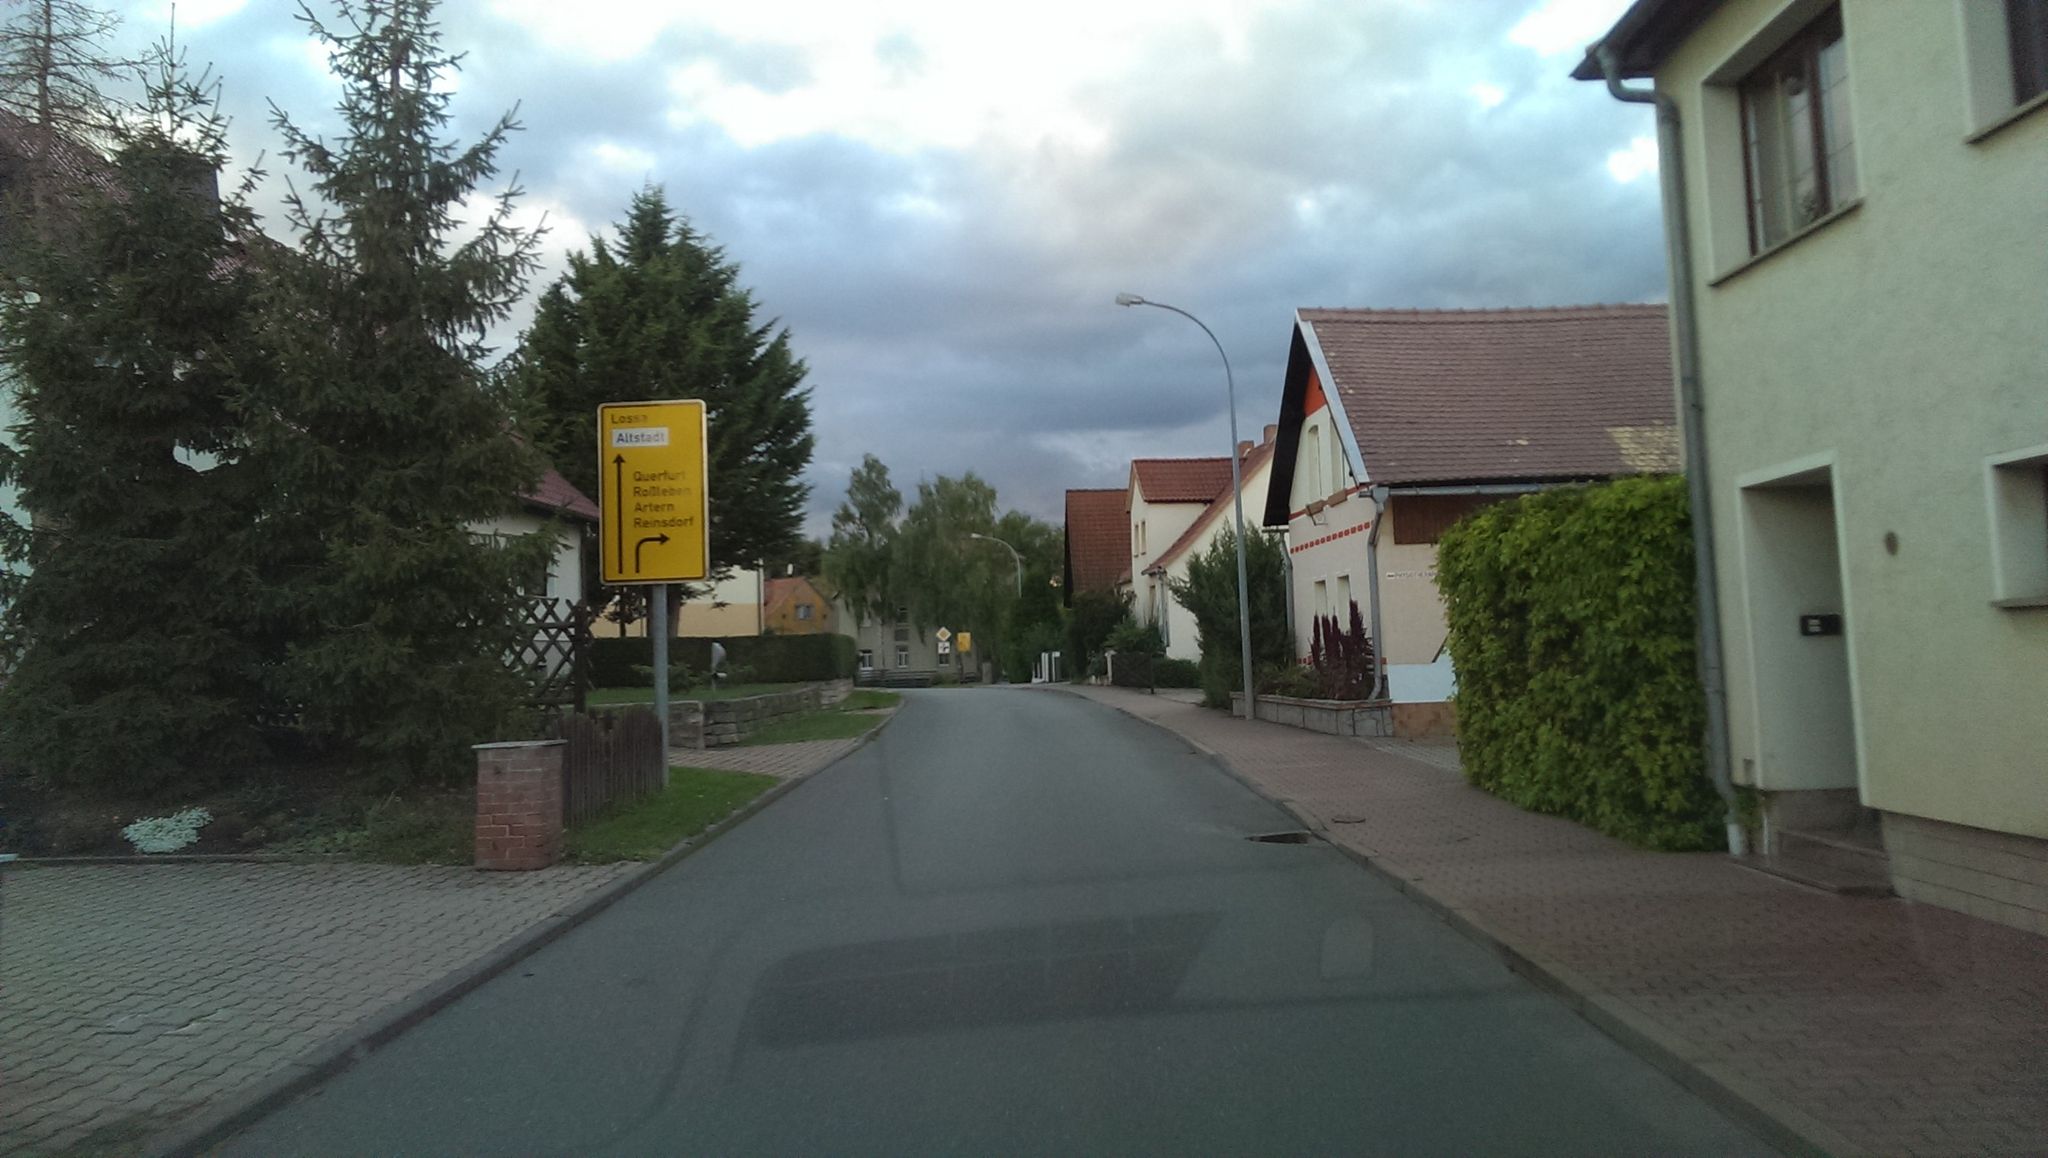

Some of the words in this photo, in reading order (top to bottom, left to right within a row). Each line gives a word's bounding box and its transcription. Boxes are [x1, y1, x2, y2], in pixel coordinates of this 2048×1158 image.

[616, 432, 665, 443] Altstadt
[635, 502, 675, 513] Artern
[633, 516, 694, 528] Reinsdorf
